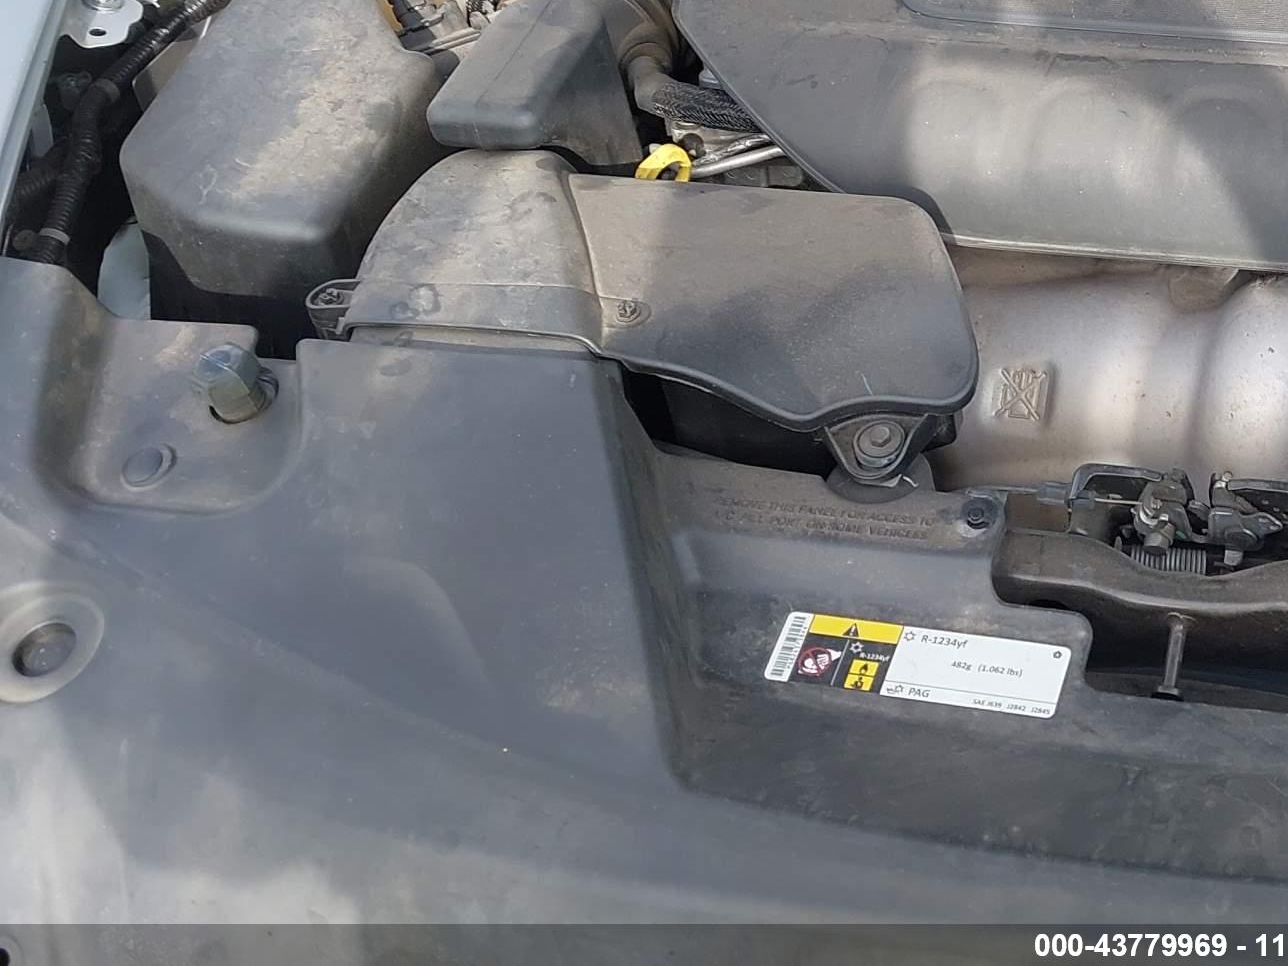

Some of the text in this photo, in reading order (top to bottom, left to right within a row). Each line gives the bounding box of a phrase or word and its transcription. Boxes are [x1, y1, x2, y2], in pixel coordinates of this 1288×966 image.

[920, 634, 969, 650] R-1234yf
[977, 663, 1006, 676] (1.062
[908, 686, 931, 699] PAG
